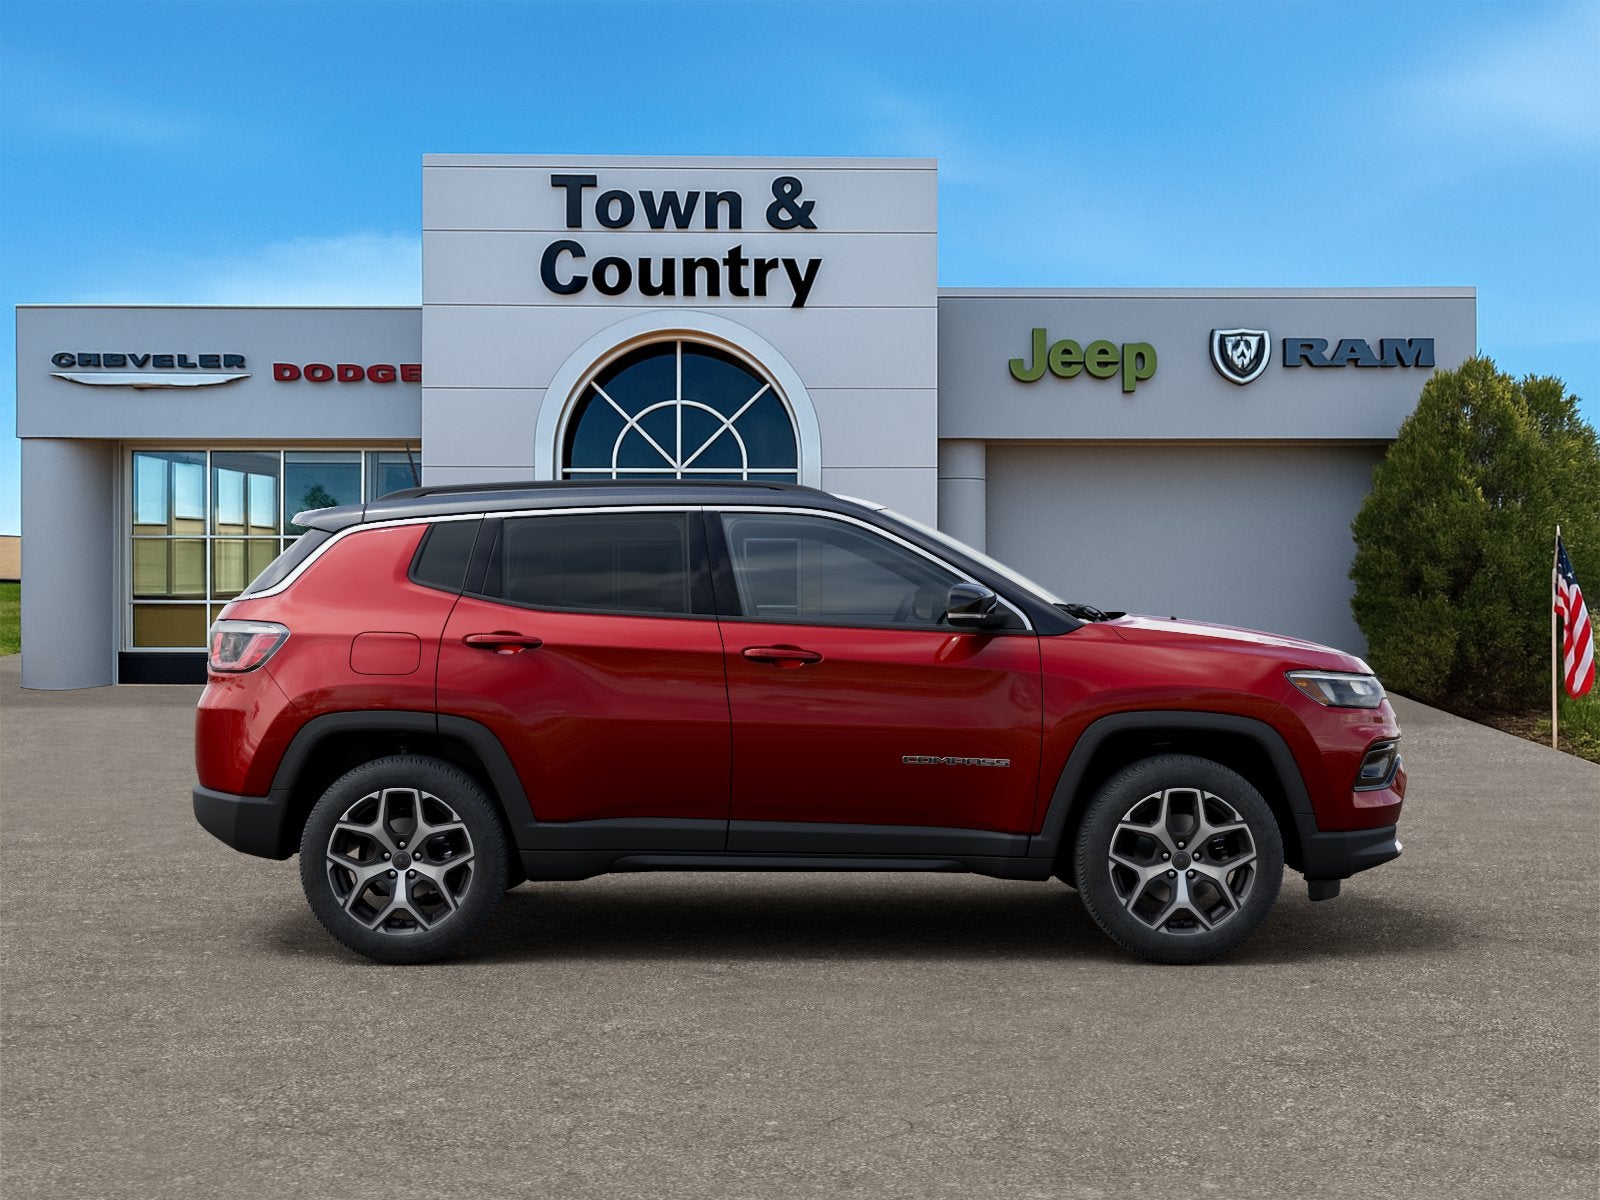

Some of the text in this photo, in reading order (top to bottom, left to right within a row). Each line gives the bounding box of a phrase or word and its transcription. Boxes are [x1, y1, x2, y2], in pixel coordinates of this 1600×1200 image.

[550, 174, 818, 230] Town &
[539, 238, 823, 308] Country
[272, 363, 422, 382] DODGE
[1009, 328, 1157, 392] Jeep
[1282, 337, 1435, 367] RAM
[902, 755, 1010, 767] COMPASS
